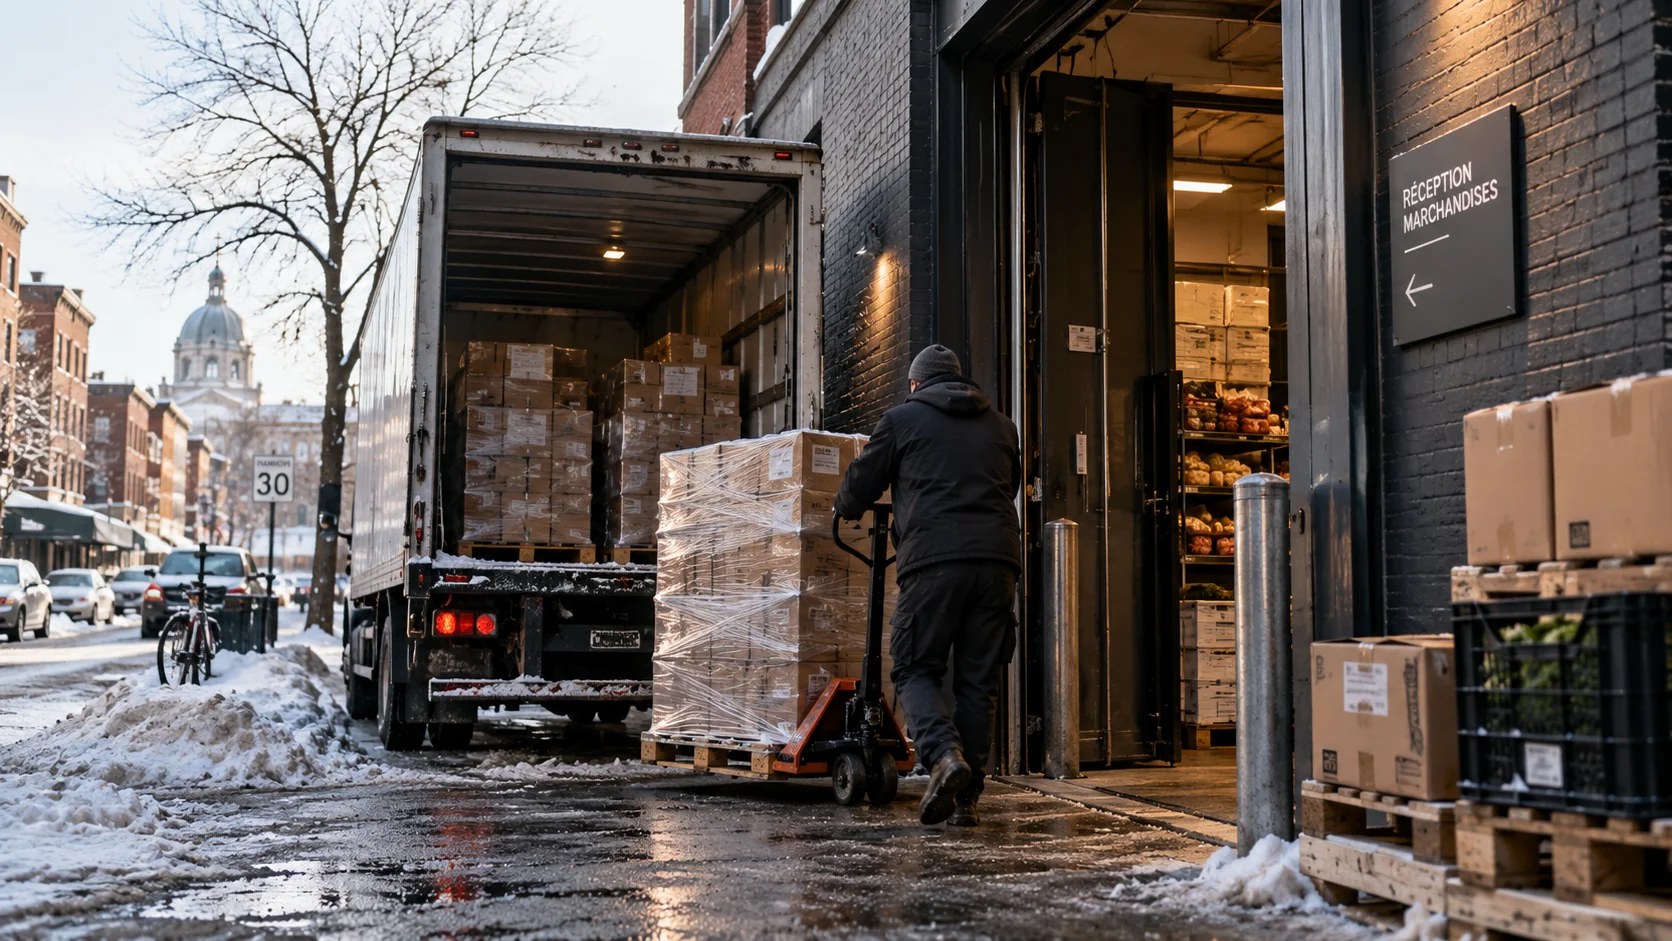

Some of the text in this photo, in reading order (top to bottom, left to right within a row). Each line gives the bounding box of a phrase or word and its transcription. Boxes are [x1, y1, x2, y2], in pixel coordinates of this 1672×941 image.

[1403, 161, 1472, 209] RÉCEPTION
[1403, 179, 1499, 234] MARCHANDISES
[257, 472, 289, 496] 30
